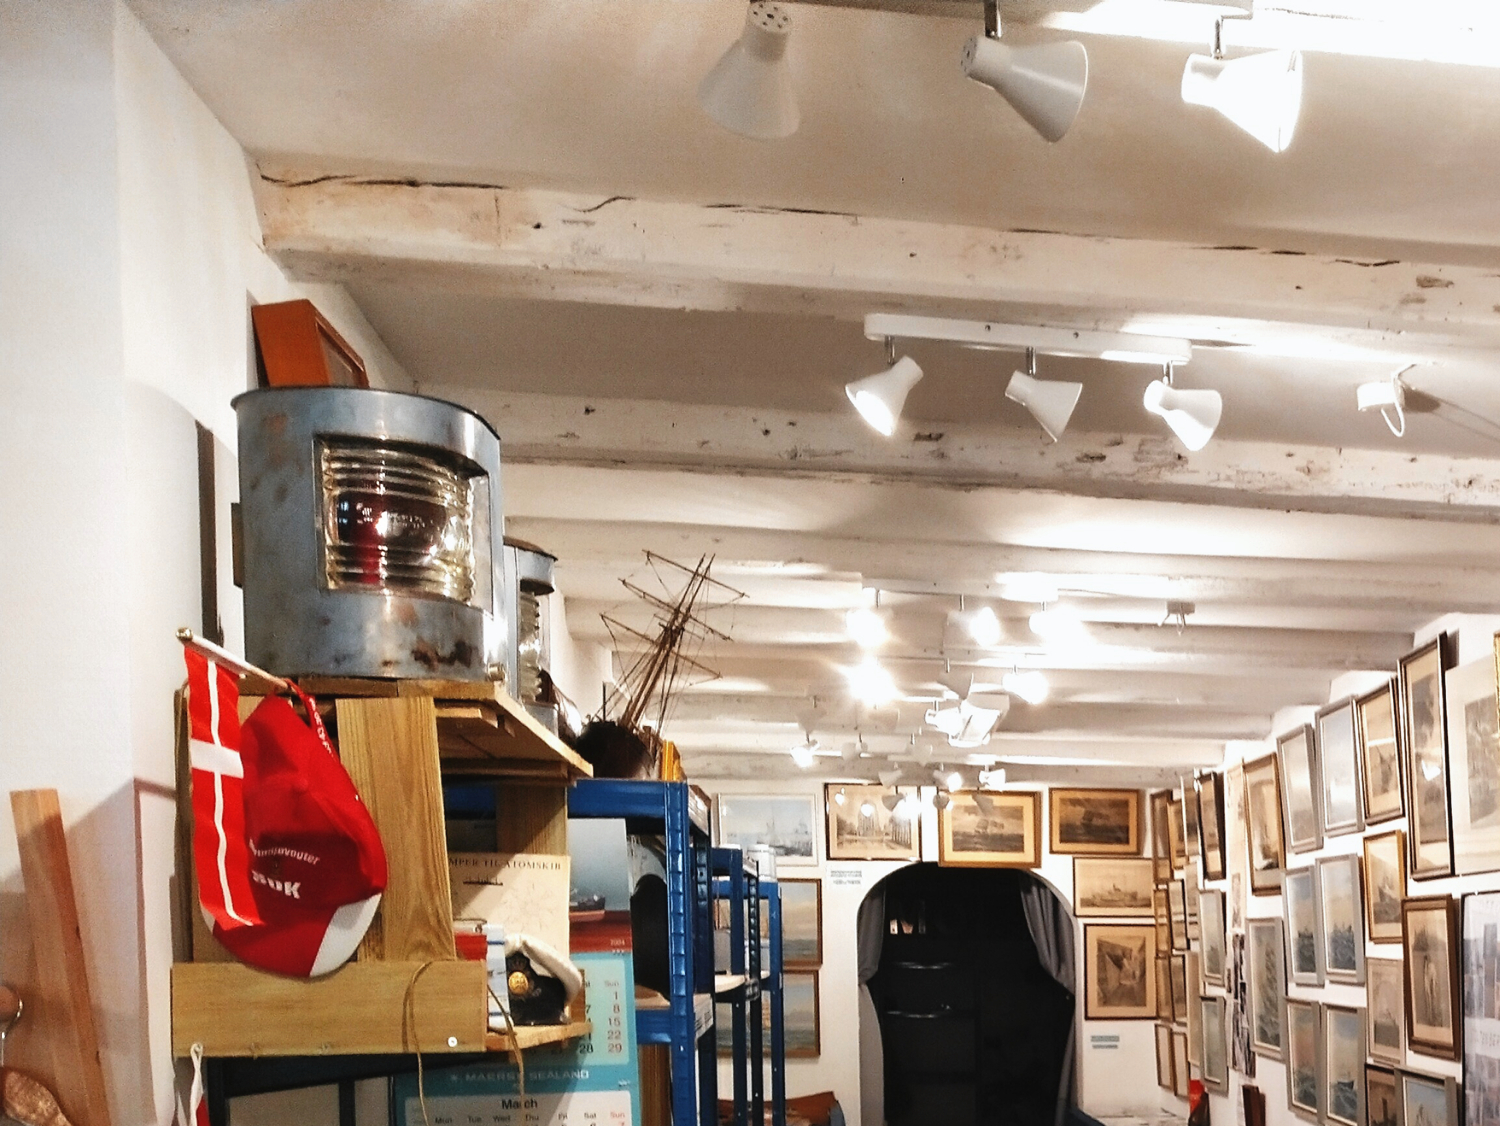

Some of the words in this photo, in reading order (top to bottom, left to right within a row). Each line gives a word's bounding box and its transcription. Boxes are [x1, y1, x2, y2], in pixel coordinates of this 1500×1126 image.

[608, 1018, 621, 1027] 15
[607, 1030, 622, 1040] 22
[579, 1044, 594, 1054] 28
[608, 1043, 622, 1053] 29
[528, 1069, 589, 1080] SEALAND
[502, 1099, 538, 1109] Mach
